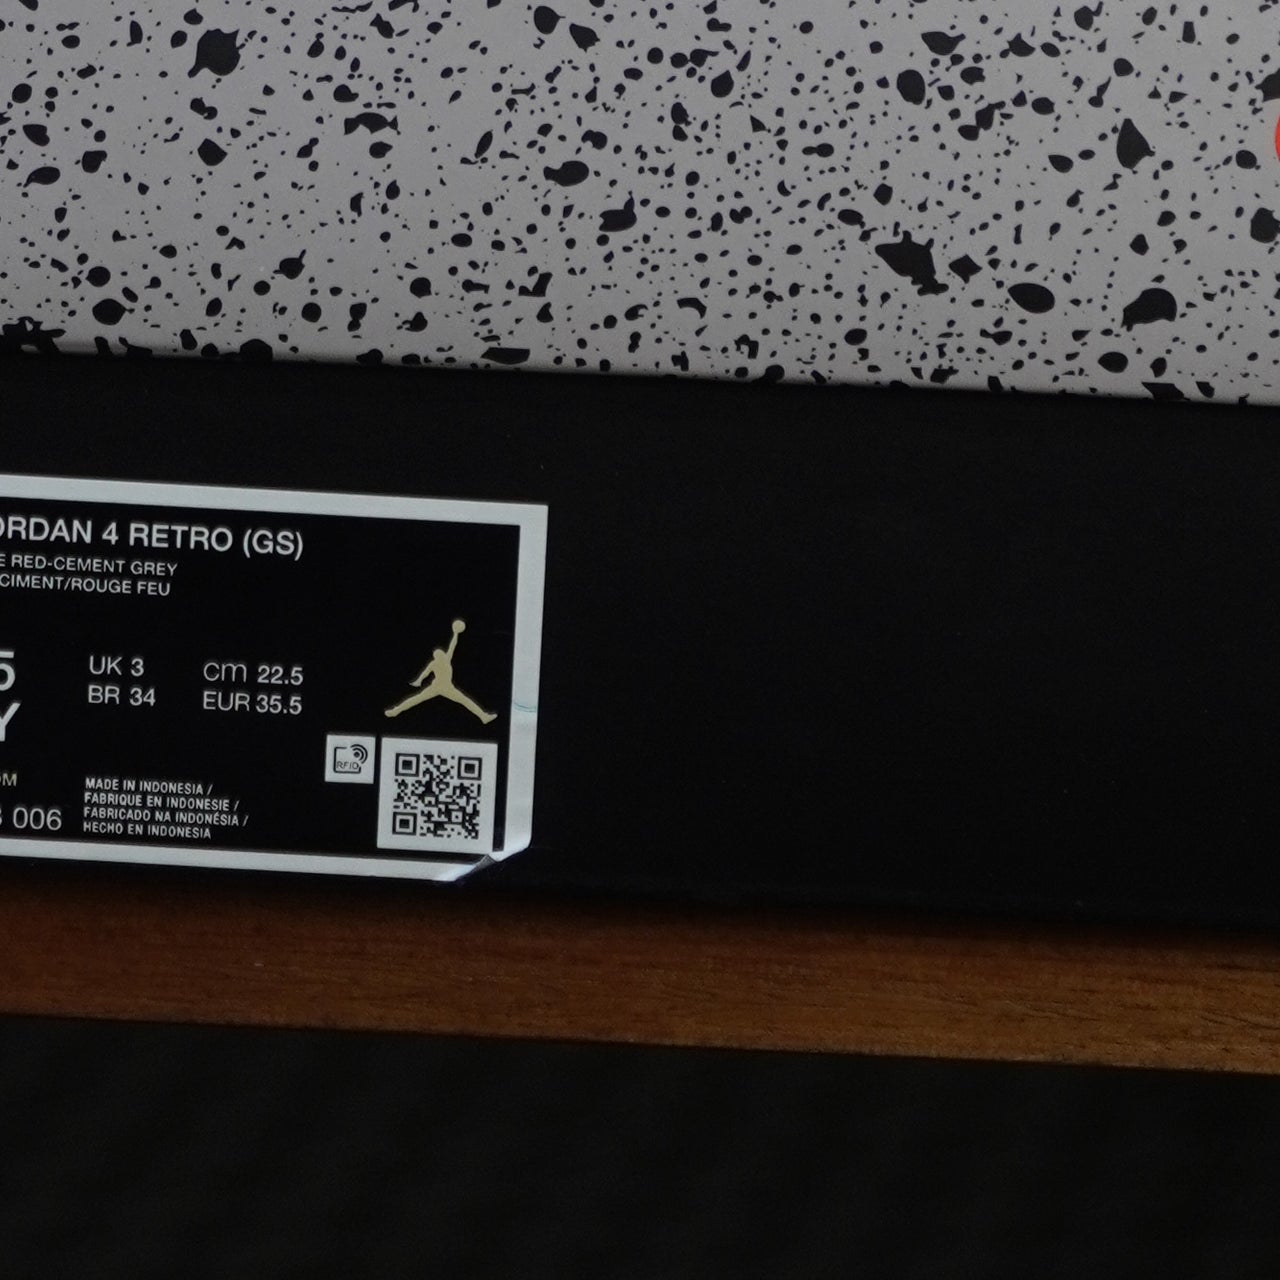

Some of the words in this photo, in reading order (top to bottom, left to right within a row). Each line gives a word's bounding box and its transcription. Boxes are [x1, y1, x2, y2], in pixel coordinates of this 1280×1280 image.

[101, 521, 119, 546] 4
[129, 522, 233, 552] RETRO
[242, 528, 304, 561] (GS)
[11, 553, 126, 573] RED-CEMENT
[130, 560, 178, 577] GREY
[137, 580, 171, 597] FEU
[89, 655, 123, 676] UK
[130, 657, 145, 677] 3
[257, 664, 304, 686] 22.5
[87, 684, 120, 705] BR
[129, 687, 156, 707] 34
[202, 690, 251, 712] EUR
[255, 694, 303, 715] 35.5
[336, 761, 359, 769] RFID
[85, 776, 119, 791] MADE
[122, 779, 136, 792] IN
[139, 781, 204, 796] INDONESIA
[84, 791, 144, 807] FABRIQUE
[146, 794, 163, 808] EN
[166, 796, 230, 811] INDONESIE
[12, 806, 62, 831] 006
[84, 807, 151, 822] FABRICADO
[154, 810, 172, 822] NA
[175, 810, 239, 826] INDONÉSIA
[83, 821, 124, 835] HECHO
[127, 823, 144, 835] EN
[147, 824, 211, 839] INDONESIA
